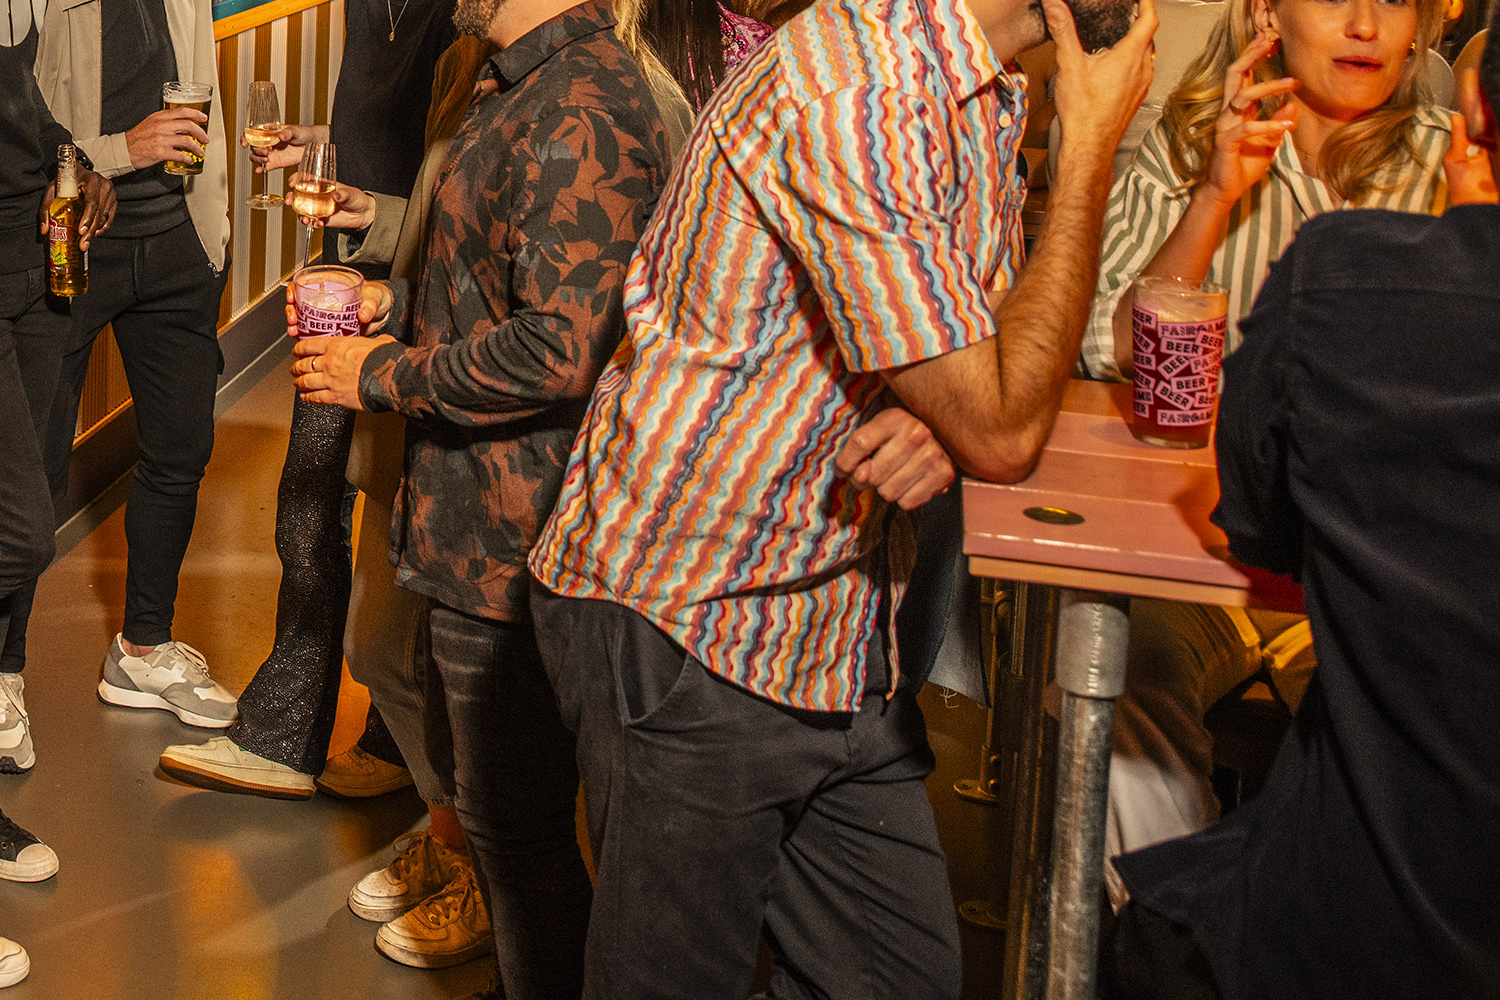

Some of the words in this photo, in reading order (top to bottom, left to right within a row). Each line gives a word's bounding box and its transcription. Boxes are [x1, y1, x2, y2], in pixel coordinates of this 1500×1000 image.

[304, 304, 356, 321] FAIRGAME
[310, 320, 334, 330] BEER
[1133, 331, 1151, 351] EER
[1166, 341, 1199, 355] BEER
[1134, 372, 1152, 390] EER
[1176, 378, 1206, 390] BEER
[1160, 386, 1191, 408] BEER
[1198, 396, 1214, 405] BEE
[1160, 411, 1213, 424] FAIRGAM
